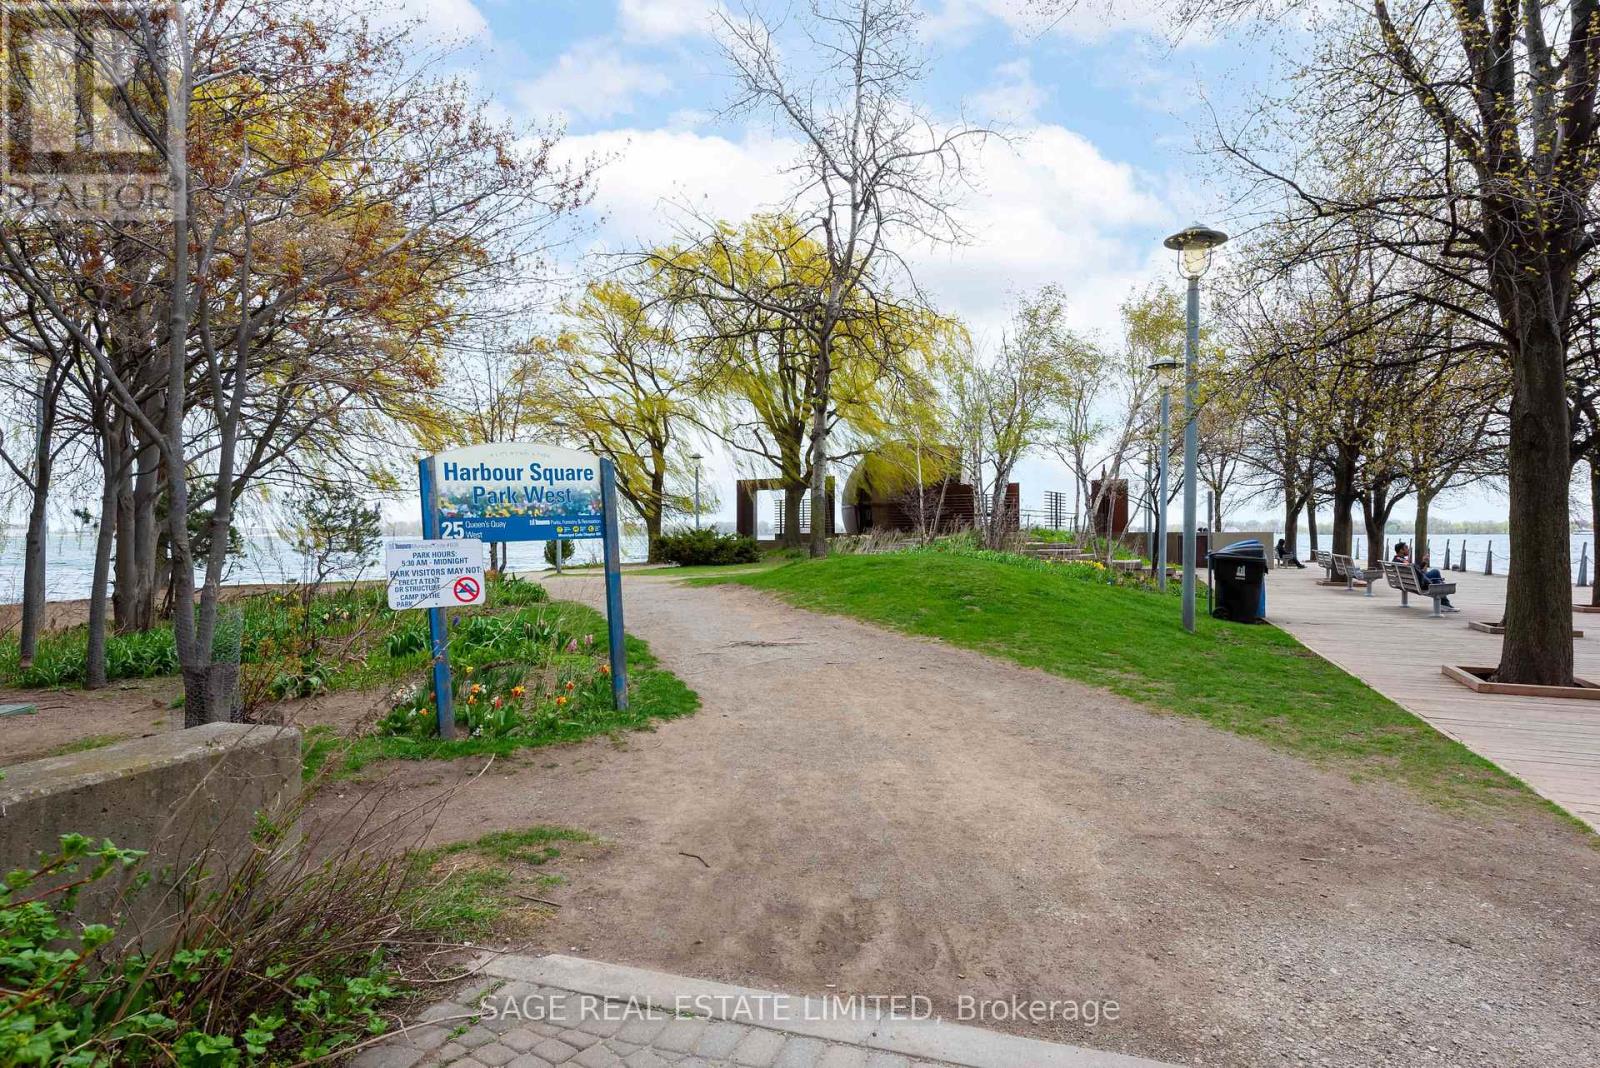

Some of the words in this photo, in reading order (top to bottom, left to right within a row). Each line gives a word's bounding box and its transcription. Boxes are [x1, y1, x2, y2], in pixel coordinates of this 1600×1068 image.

[444, 462, 523, 481] Harbour
[530, 462, 594, 485] Square
[473, 486, 517, 503] Park
[524, 486, 571, 503] West
[441, 521, 465, 539] 25
[433, 557, 468, 565] MIDNIGHT
[411, 568, 445, 577] VISITORS
[447, 567, 463, 575] MAY
[400, 593, 419, 601] CAMP
